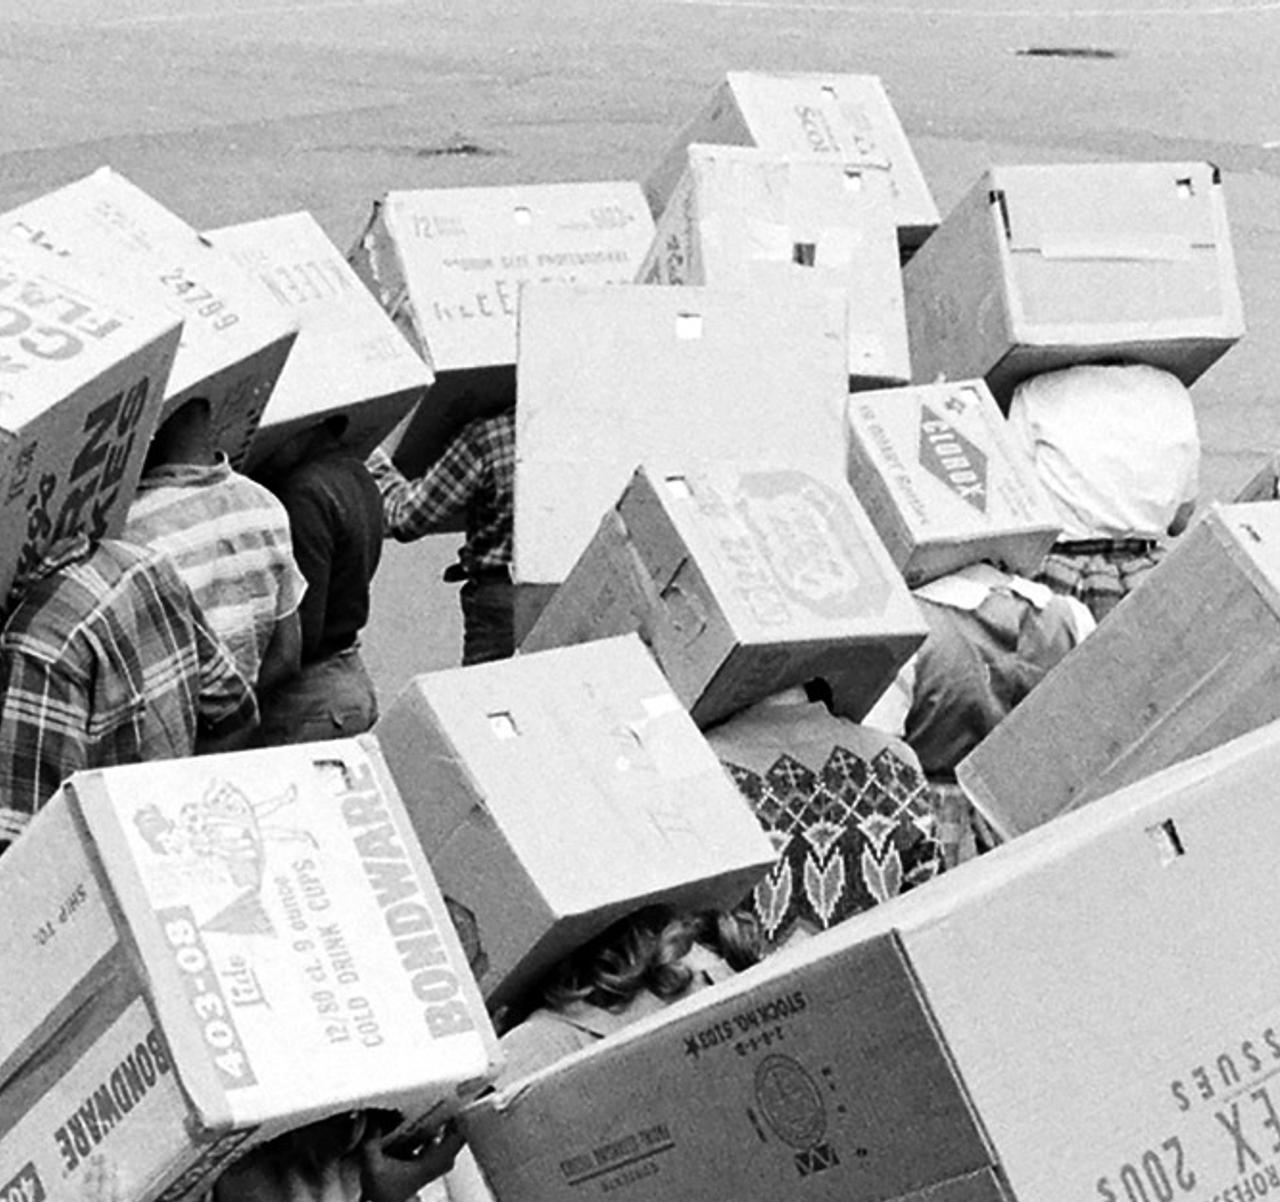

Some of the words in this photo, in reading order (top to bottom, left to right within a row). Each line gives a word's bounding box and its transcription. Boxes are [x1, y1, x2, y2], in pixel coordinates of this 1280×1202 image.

[922, 418, 987, 498] CLOROX
[291, 858, 331, 912] CUPS
[317, 923, 359, 985] DRINK
[165, 918, 242, 1079] 403-08
[347, 996, 384, 1048] COLD
[756, 991, 806, 1023] STOCK
[54, 1029, 172, 1172] BONDWARE
